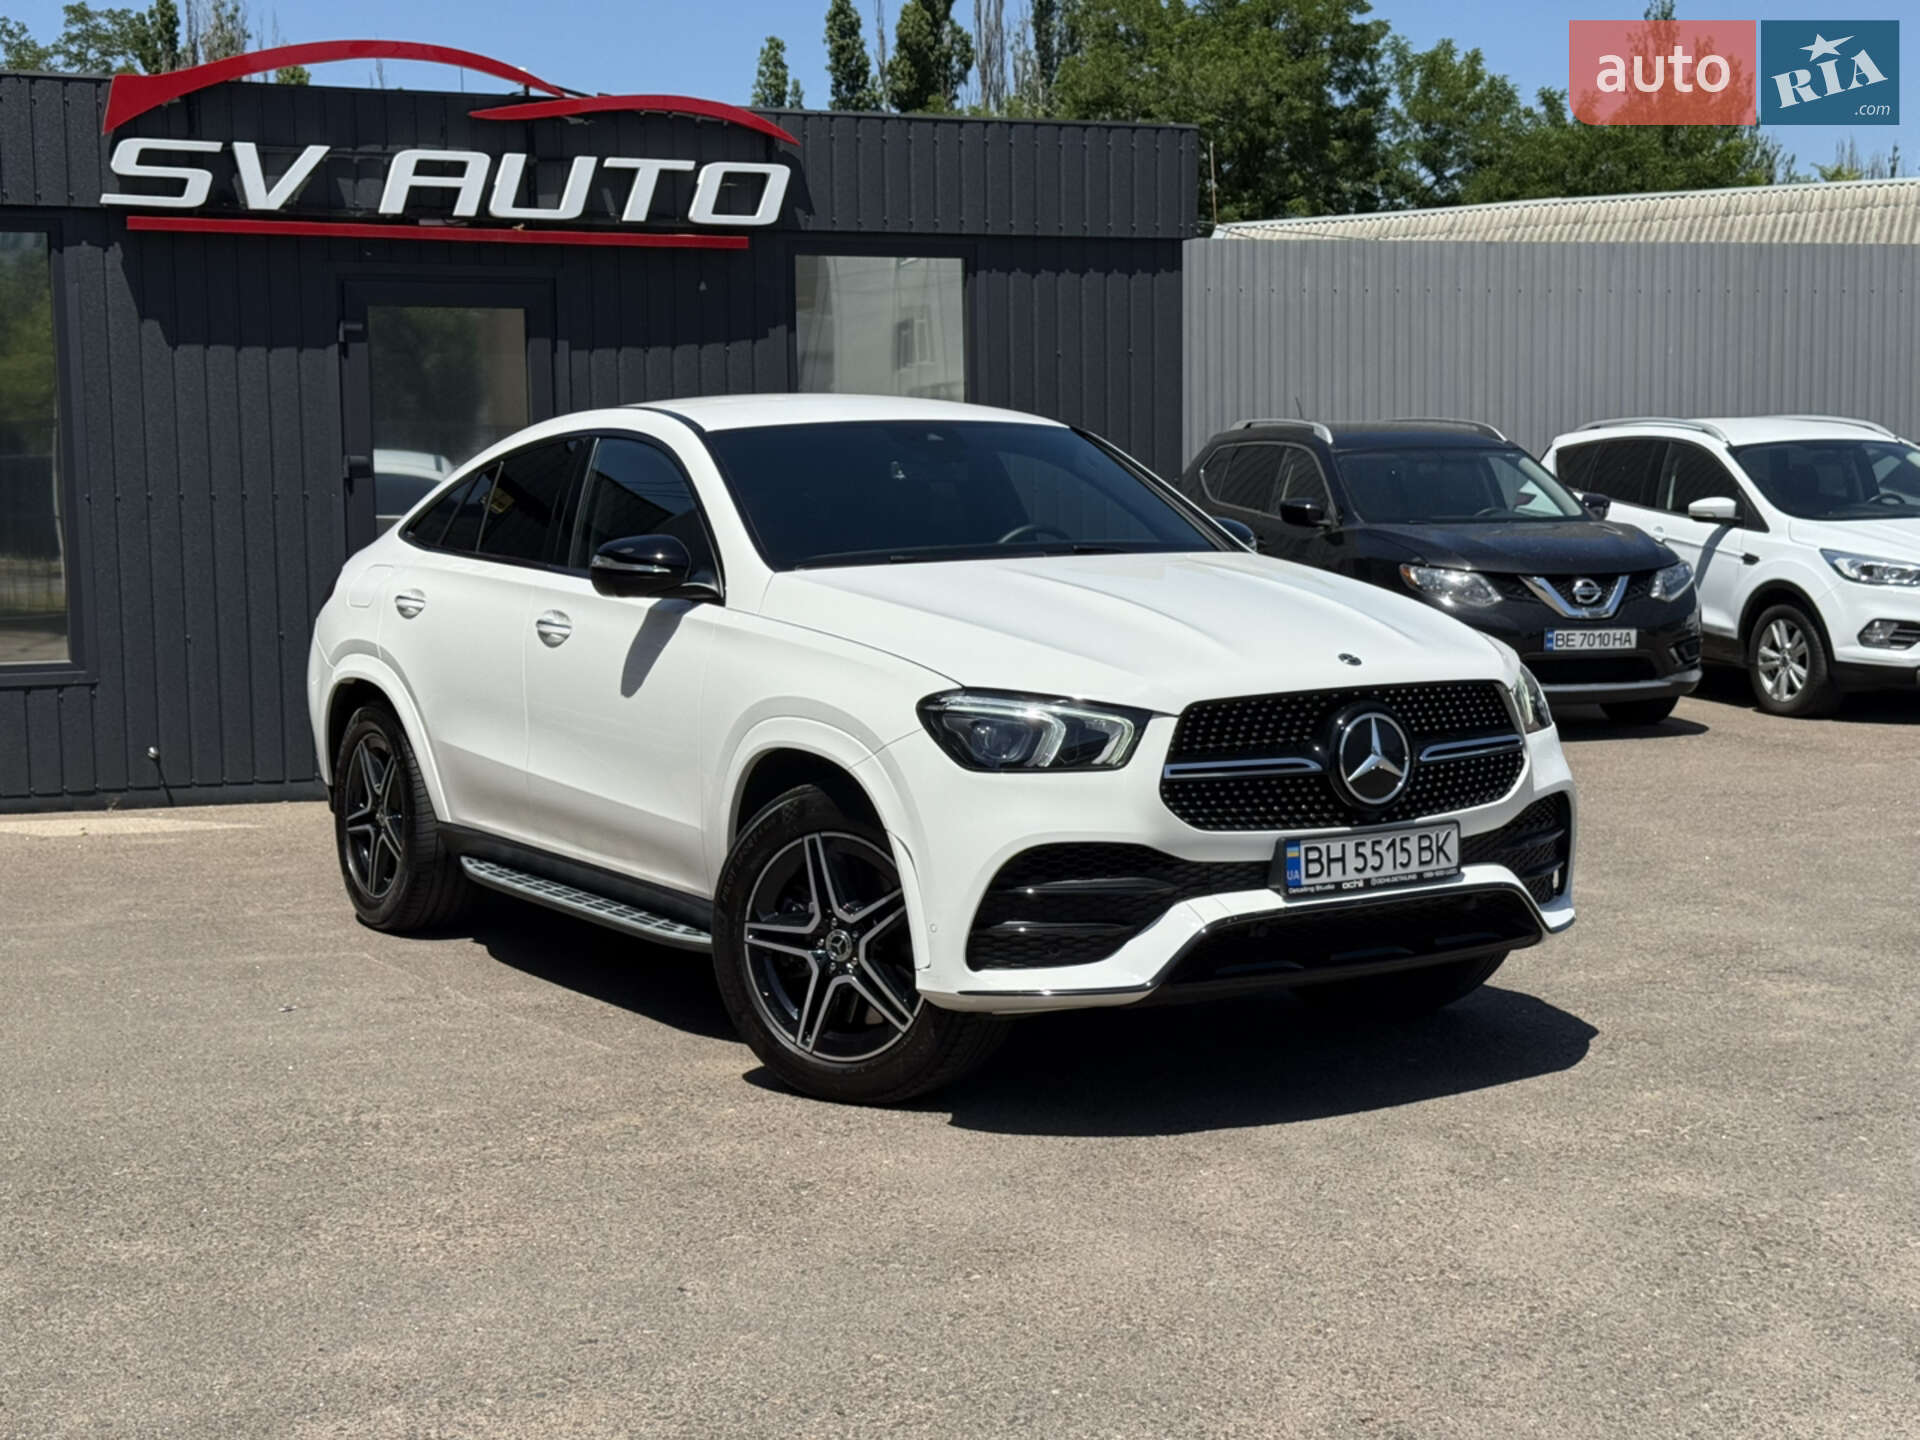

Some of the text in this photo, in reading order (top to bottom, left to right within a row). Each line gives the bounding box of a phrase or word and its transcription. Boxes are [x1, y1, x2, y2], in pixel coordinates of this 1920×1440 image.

[100, 137, 791, 226] SV AUTO
[1555, 631, 1633, 648] BE 7010 HA
[1304, 831, 1452, 879] BH 5515 BK
[1286, 869, 1300, 880] UA
